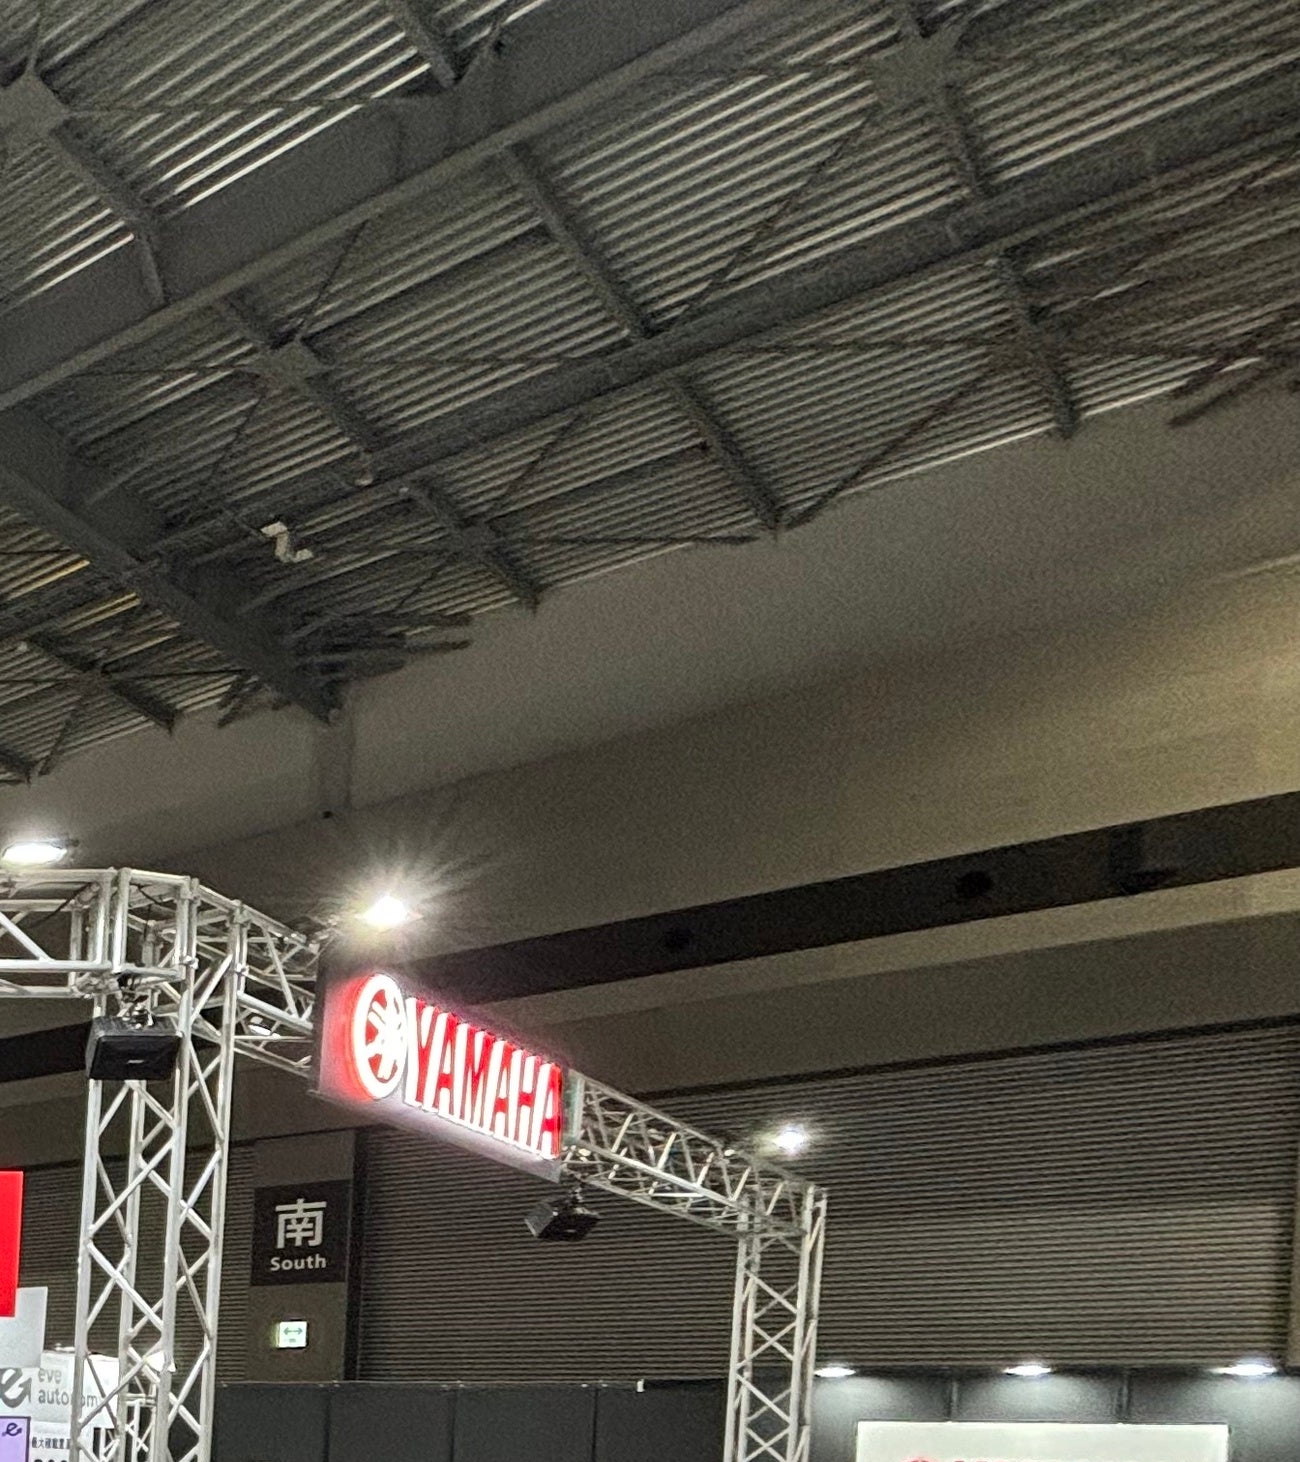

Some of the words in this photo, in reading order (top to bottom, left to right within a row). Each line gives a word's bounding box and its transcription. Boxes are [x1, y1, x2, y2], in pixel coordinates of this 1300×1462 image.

[404, 997, 564, 1161] YAMAHA
[275, 1198, 327, 1249] 南
[270, 1253, 327, 1271] South
[38, 1368, 62, 1384] eve
